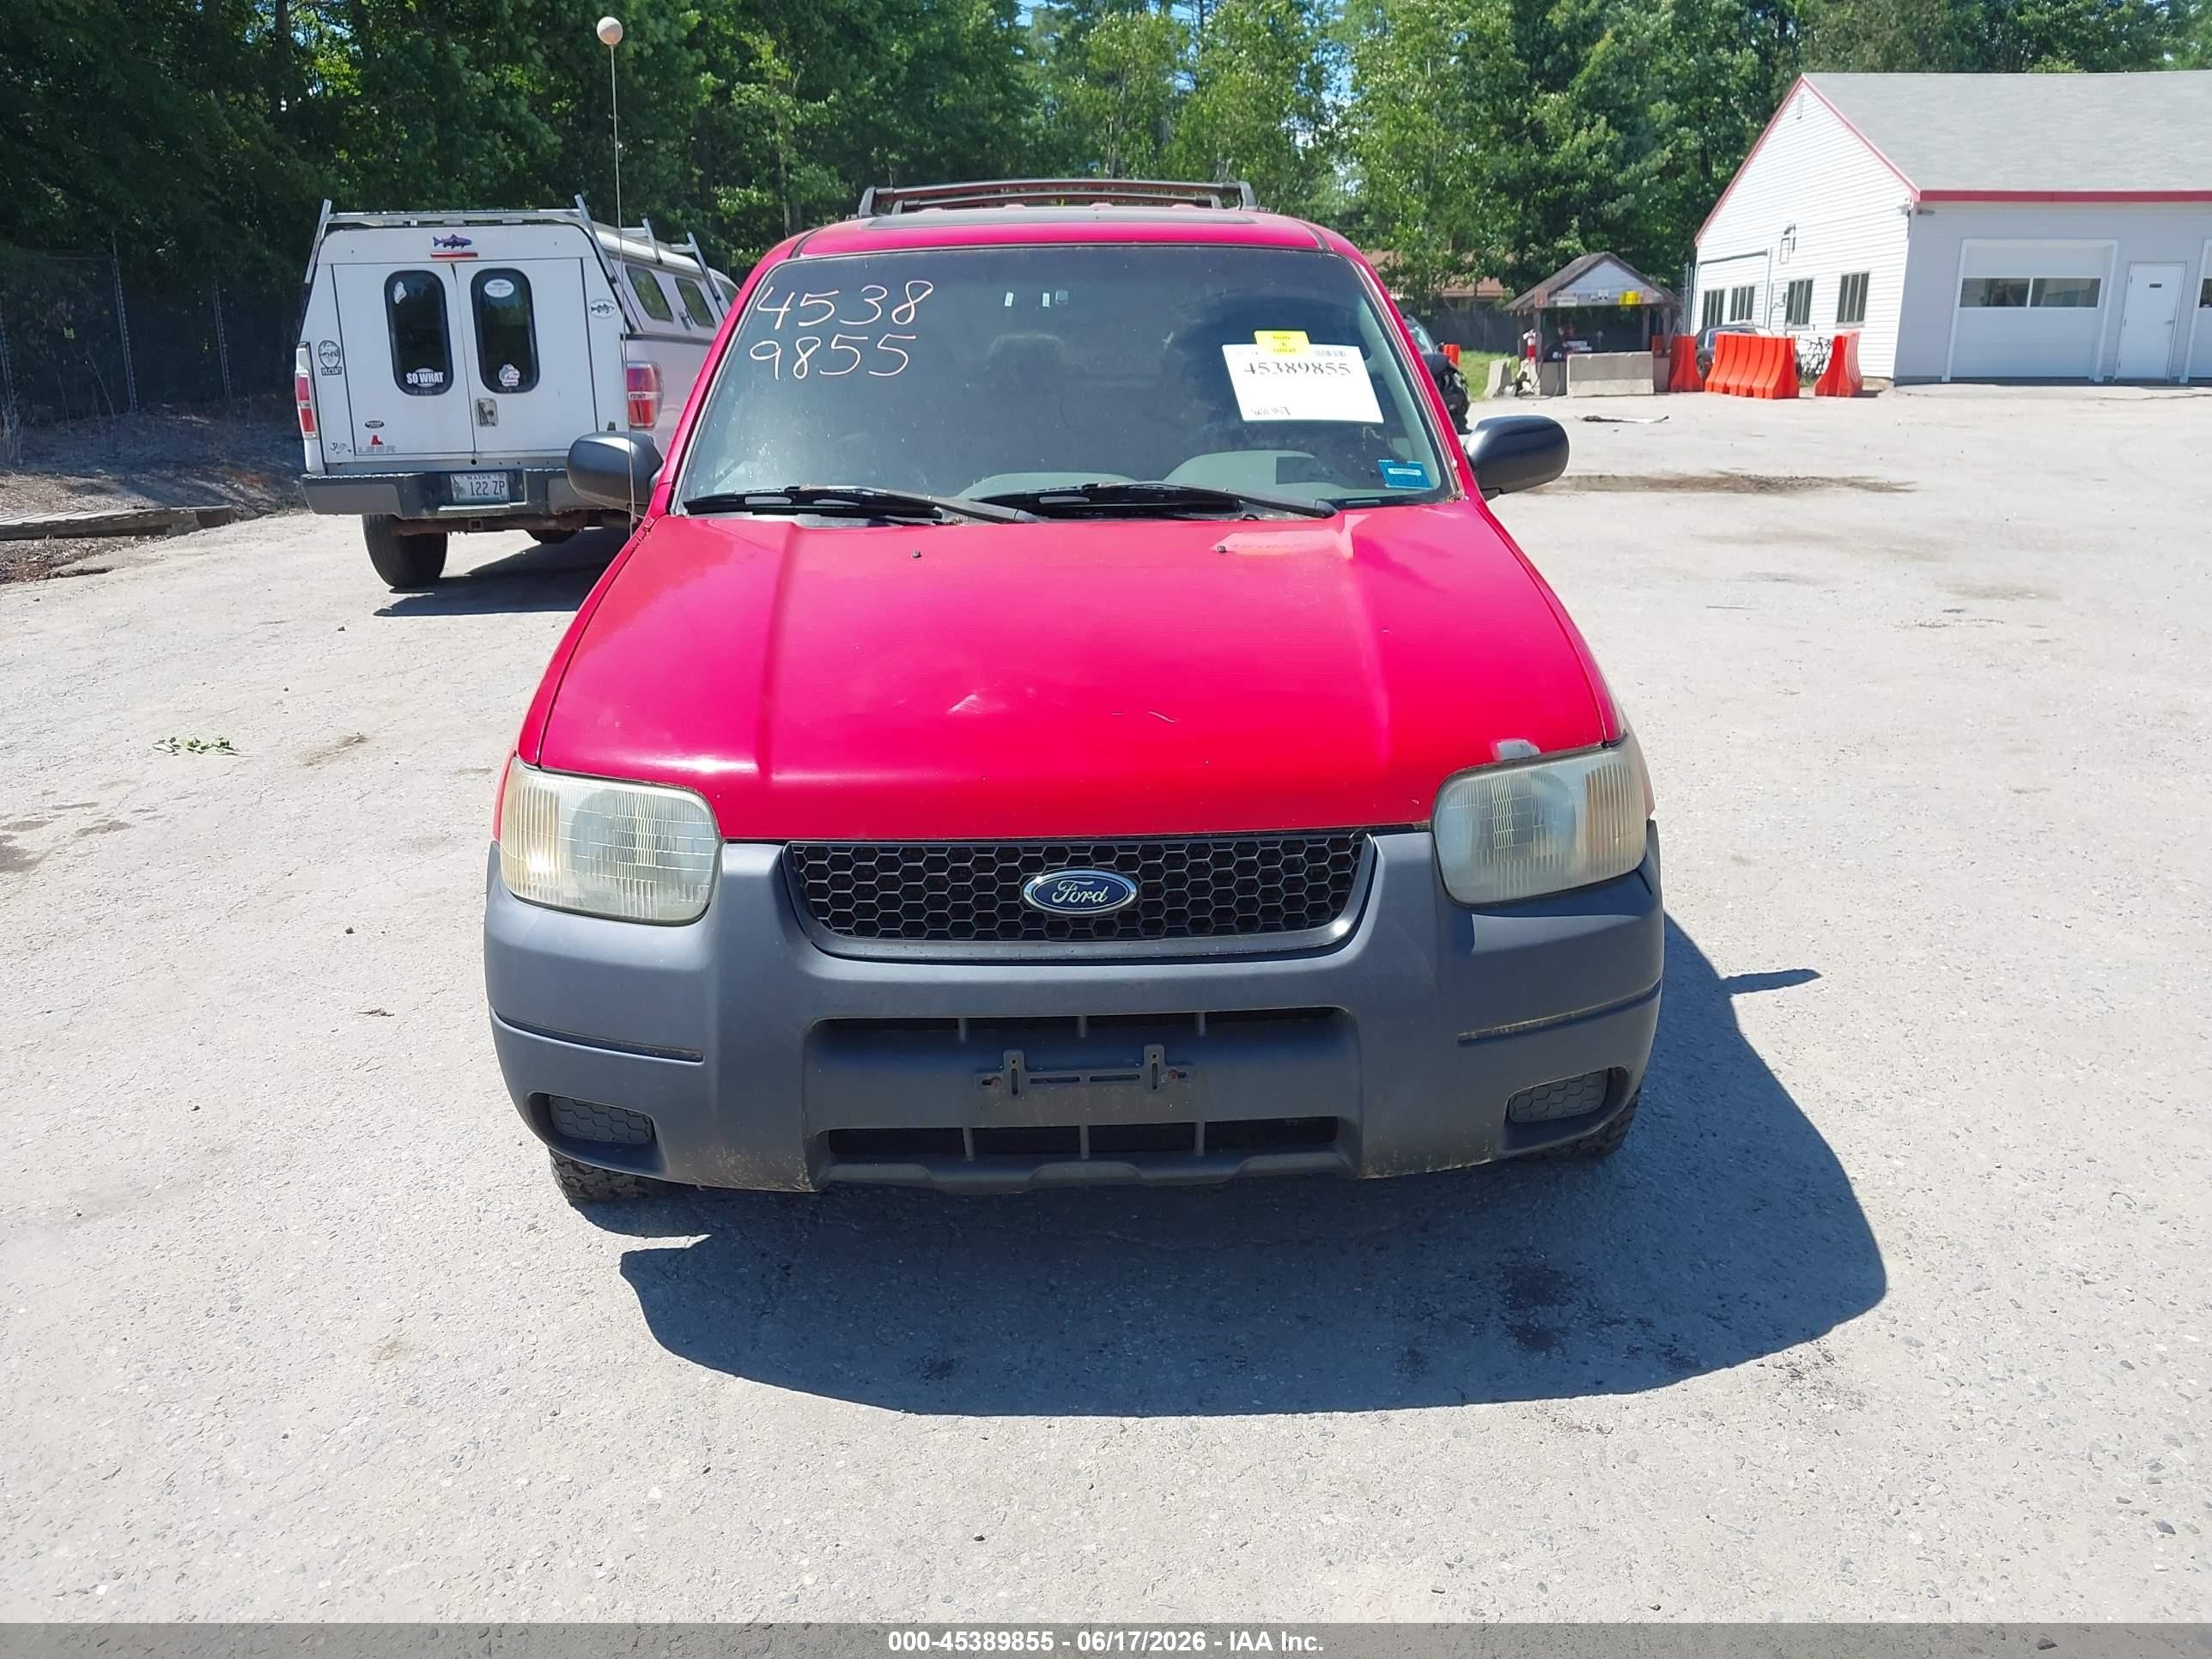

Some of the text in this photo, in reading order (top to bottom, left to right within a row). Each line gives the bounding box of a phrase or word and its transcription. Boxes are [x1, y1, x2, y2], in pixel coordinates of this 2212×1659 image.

[757, 280, 934, 331] 4538
[749, 333, 916, 380] 9855
[406, 372, 444, 384] SO WHAT
[1244, 362, 1351, 376] 45389855
[470, 480, 505, 495] 122 ZP
[1052, 880, 1109, 903] Ford
